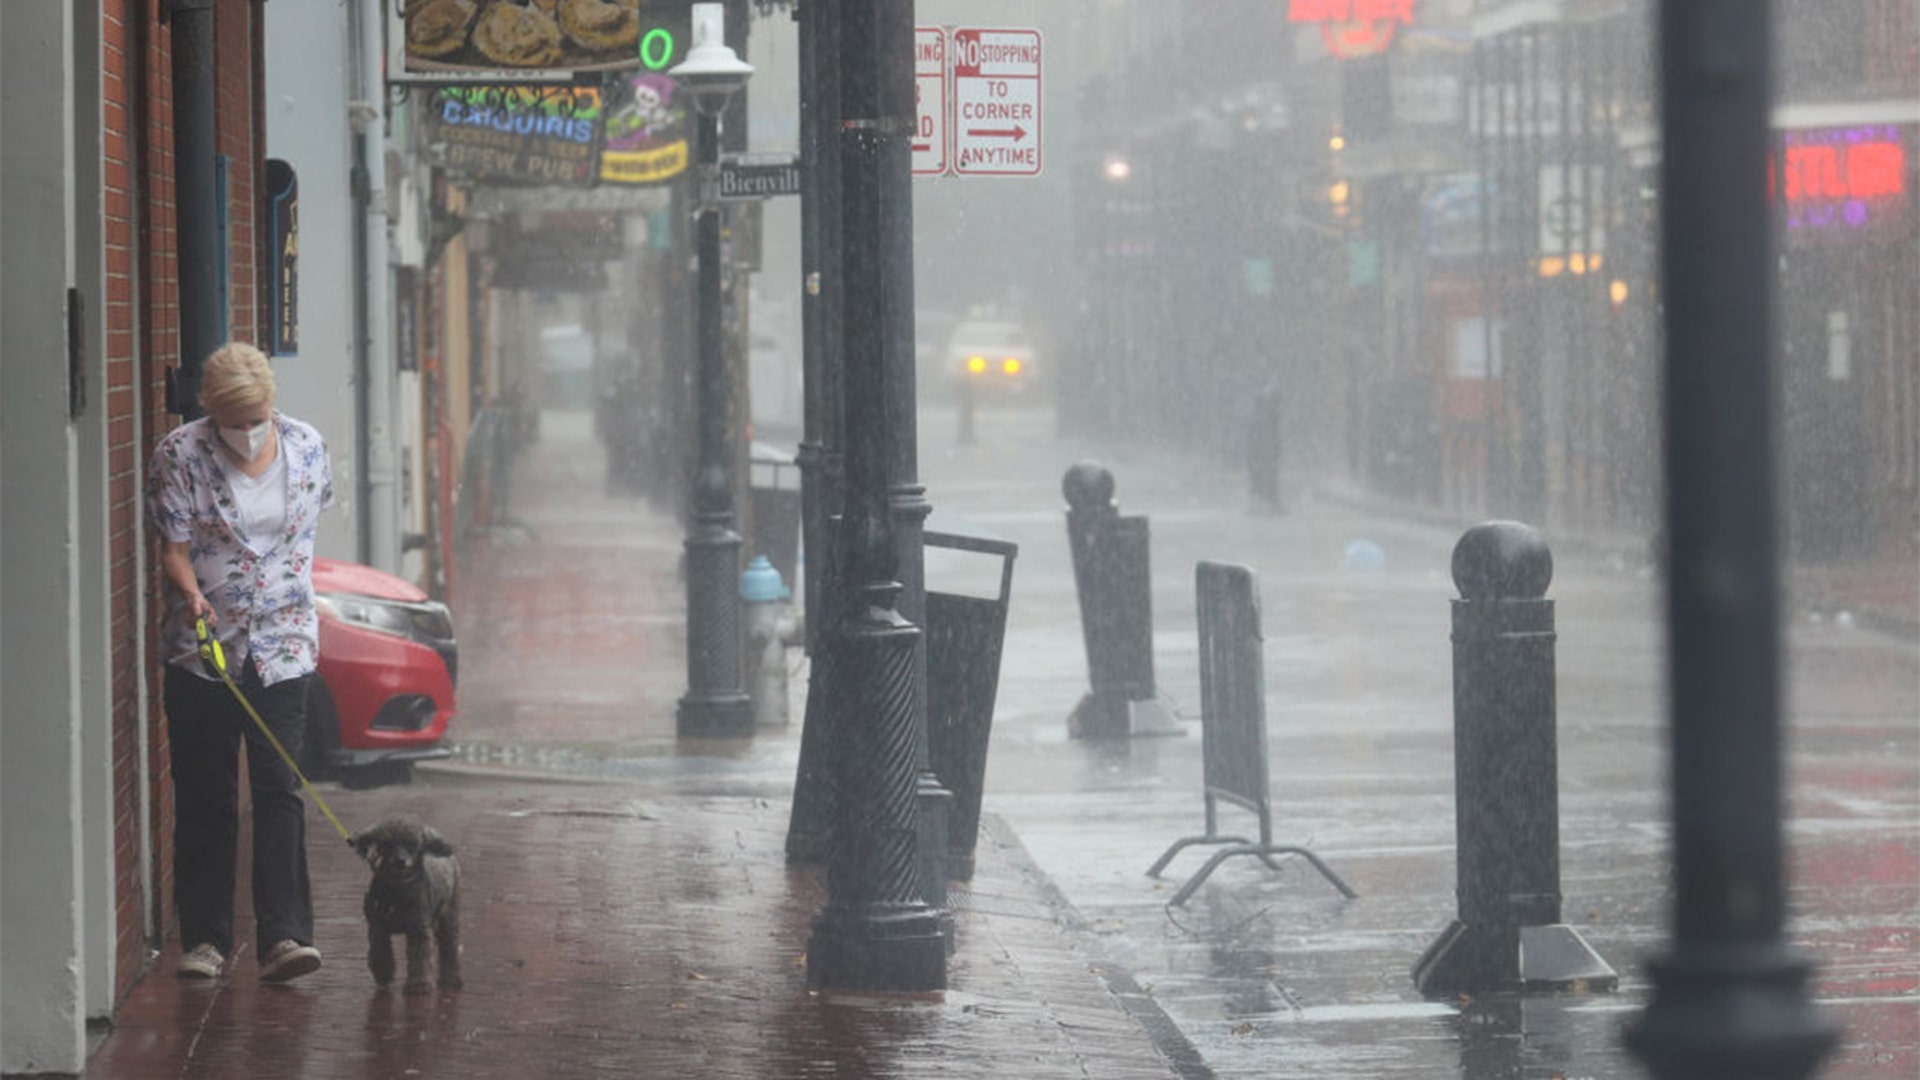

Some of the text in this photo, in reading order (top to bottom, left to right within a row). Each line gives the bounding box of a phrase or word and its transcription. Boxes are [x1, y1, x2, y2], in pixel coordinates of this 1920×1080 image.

[915, 44, 941, 62] ING
[955, 35, 1038, 67] NO STOPPING
[987, 81, 1008, 97] TO
[963, 103, 1032, 119] CORNER
[914, 115, 933, 137] D
[961, 147, 1035, 165] ANYTIME
